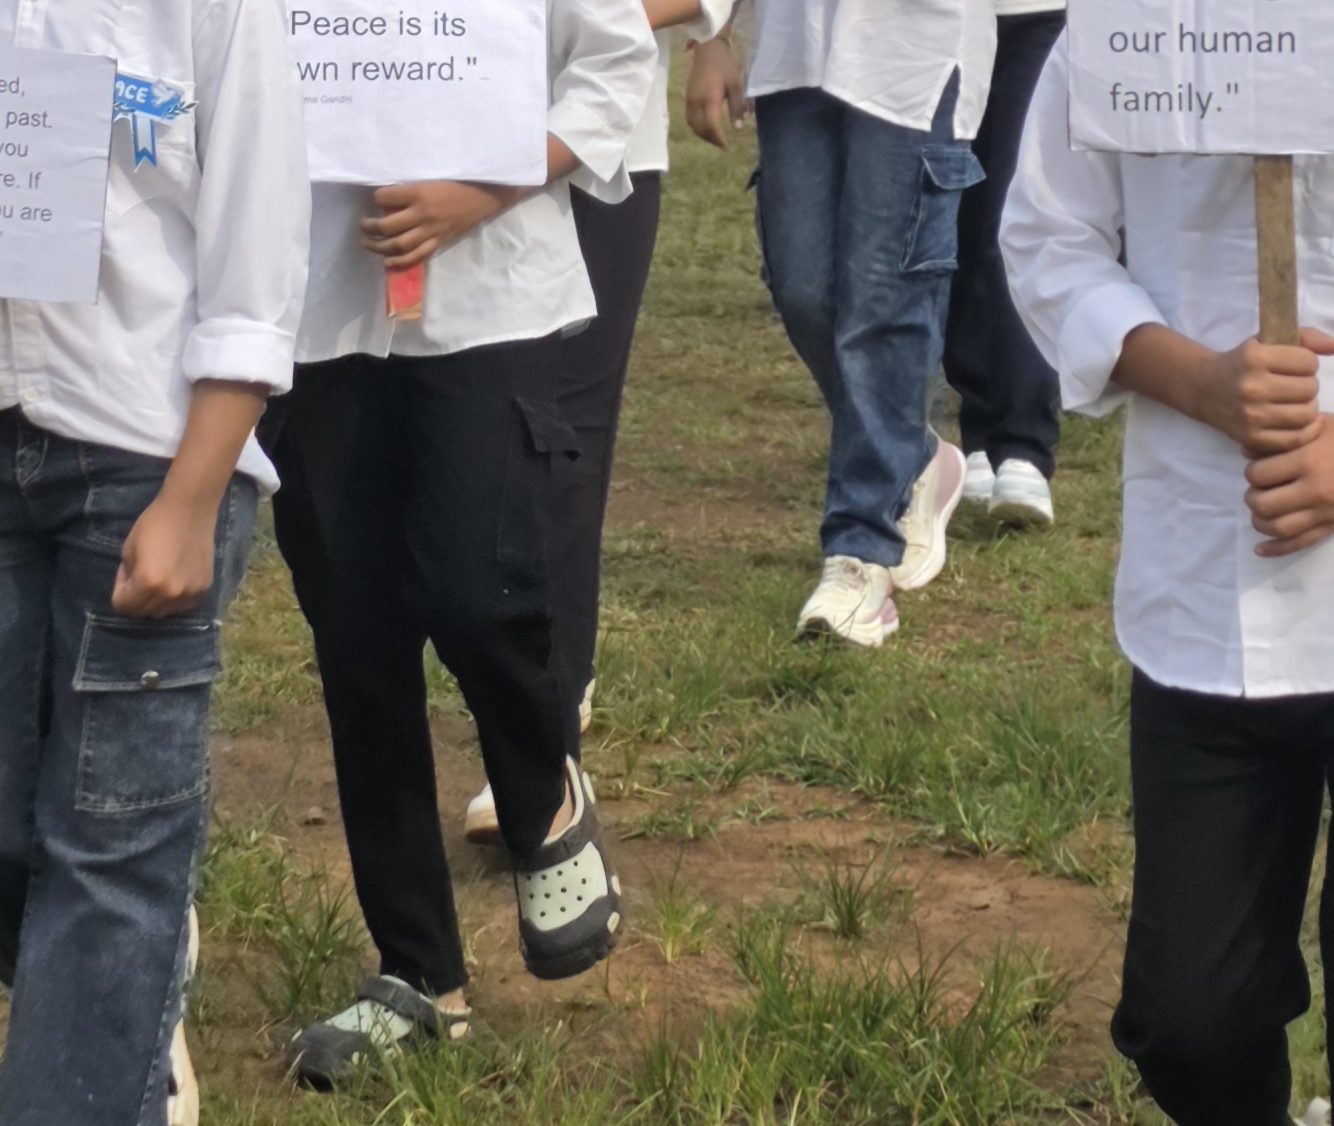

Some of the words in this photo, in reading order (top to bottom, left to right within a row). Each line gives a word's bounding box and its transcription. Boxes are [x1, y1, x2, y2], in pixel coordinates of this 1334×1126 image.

[289, 9, 387, 36] Peace
[399, 10, 422, 36] is
[433, 10, 466, 36] its
[1109, 29, 1166, 54] our
[1179, 22, 1296, 54] human
[296, 60, 339, 82] wn
[115, 80, 149, 103] ACE
[6, 109, 52, 129] past.
[28, 171, 41, 189] If
[20, 205, 52, 222] are
